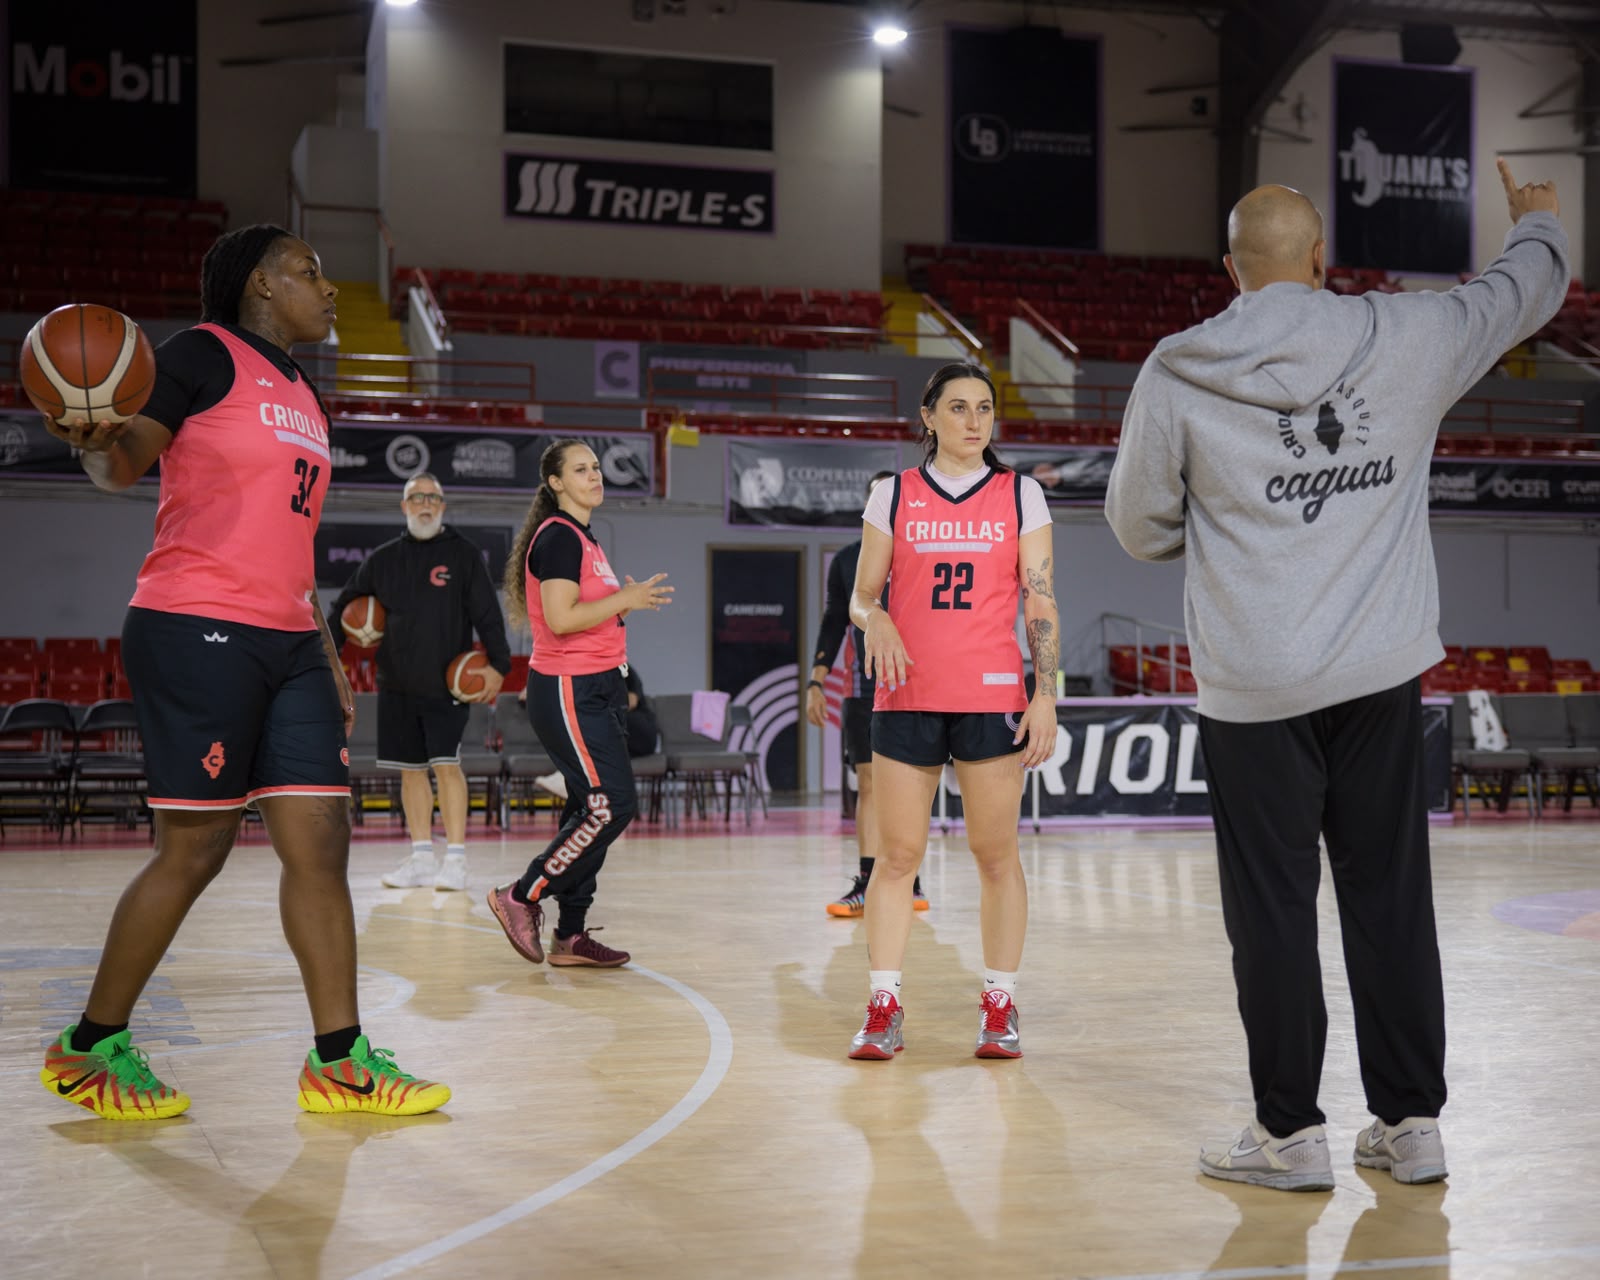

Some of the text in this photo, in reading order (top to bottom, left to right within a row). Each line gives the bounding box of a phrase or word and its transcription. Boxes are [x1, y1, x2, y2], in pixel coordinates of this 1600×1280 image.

[13, 43, 180, 104] Mobil
[585, 179, 766, 227] TRIPLE-S
[650, 358, 796, 375] PREFERENCIA
[697, 376, 750, 388] ESTE
[259, 402, 329, 448] CRIOLLA
[1277, 407, 1307, 459] CRIOL
[1336, 379, 1370, 446] ASQUET
[787, 467, 868, 481] COOPERATIV
[1265, 455, 1397, 524] caguas
[905, 520, 1005, 542] CRIOLLAS
[931, 562, 974, 610] 22
